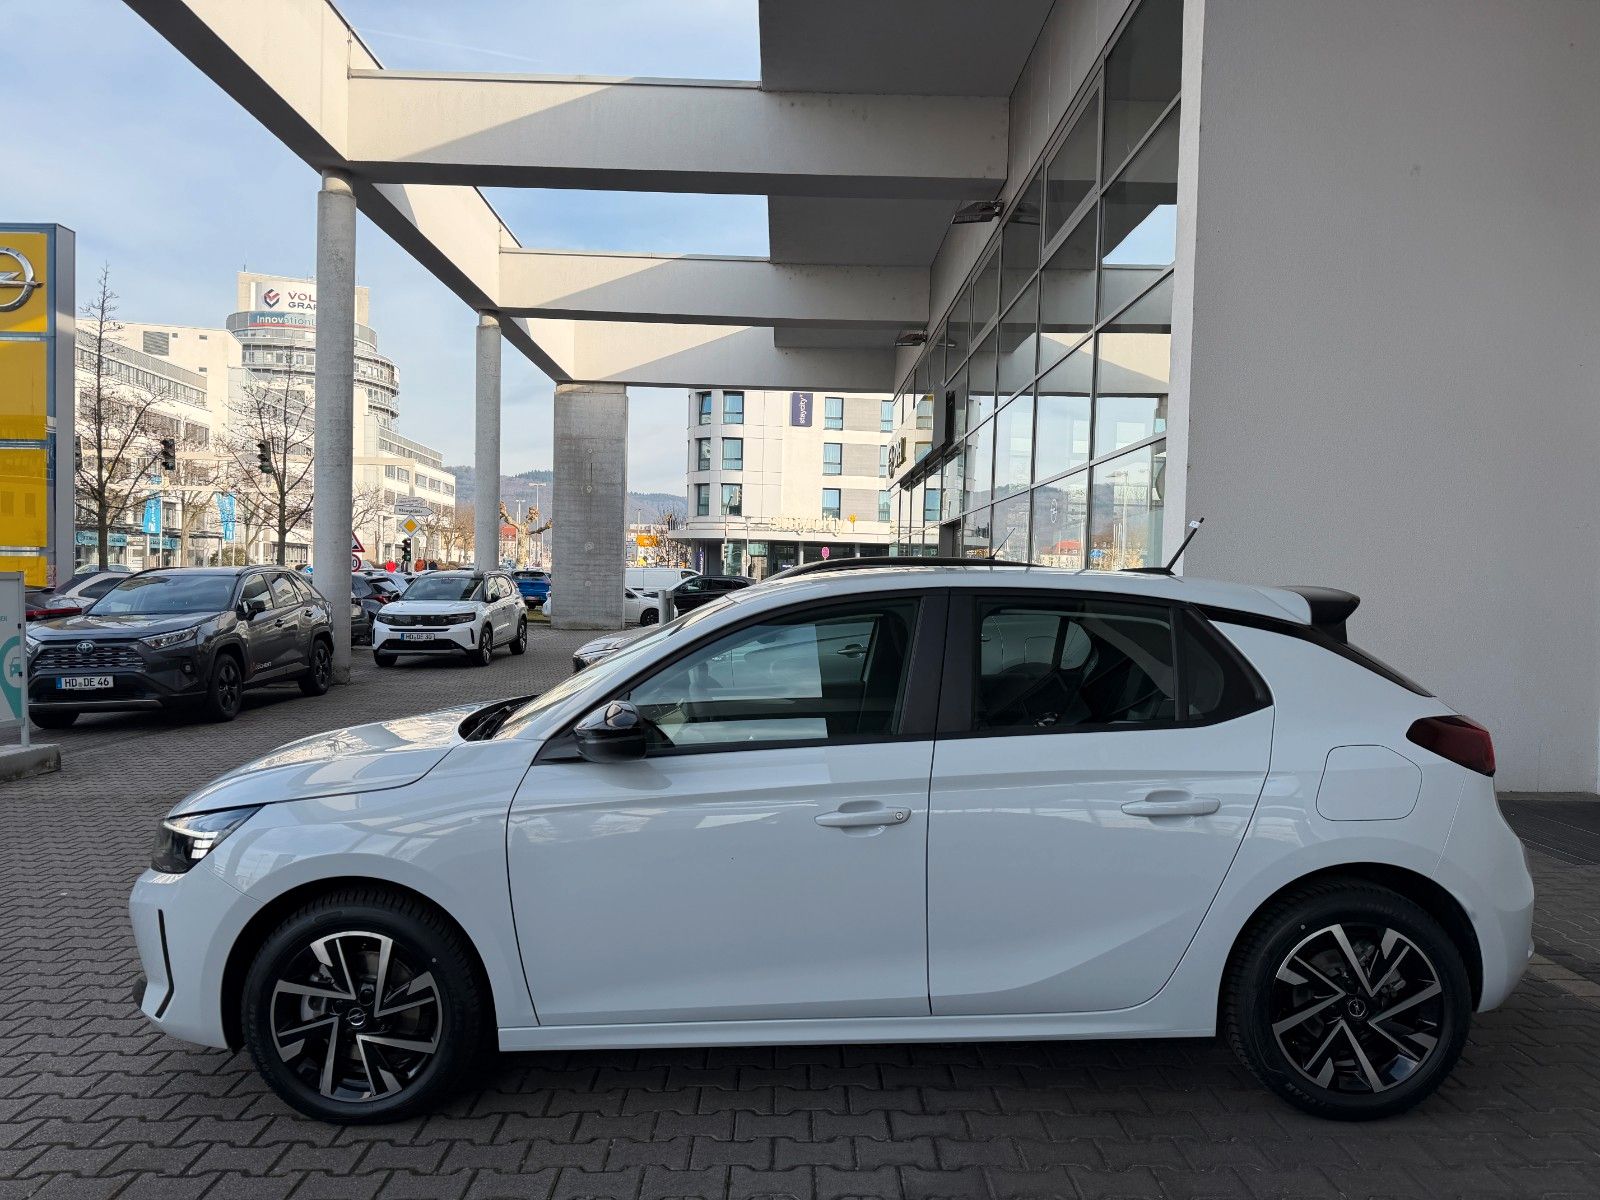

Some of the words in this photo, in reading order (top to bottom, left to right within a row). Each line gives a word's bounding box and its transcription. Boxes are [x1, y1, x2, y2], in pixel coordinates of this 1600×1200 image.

[64, 678, 78, 688] HD
[83, 677, 96, 687] DE
[97, 677, 110, 686] 46
